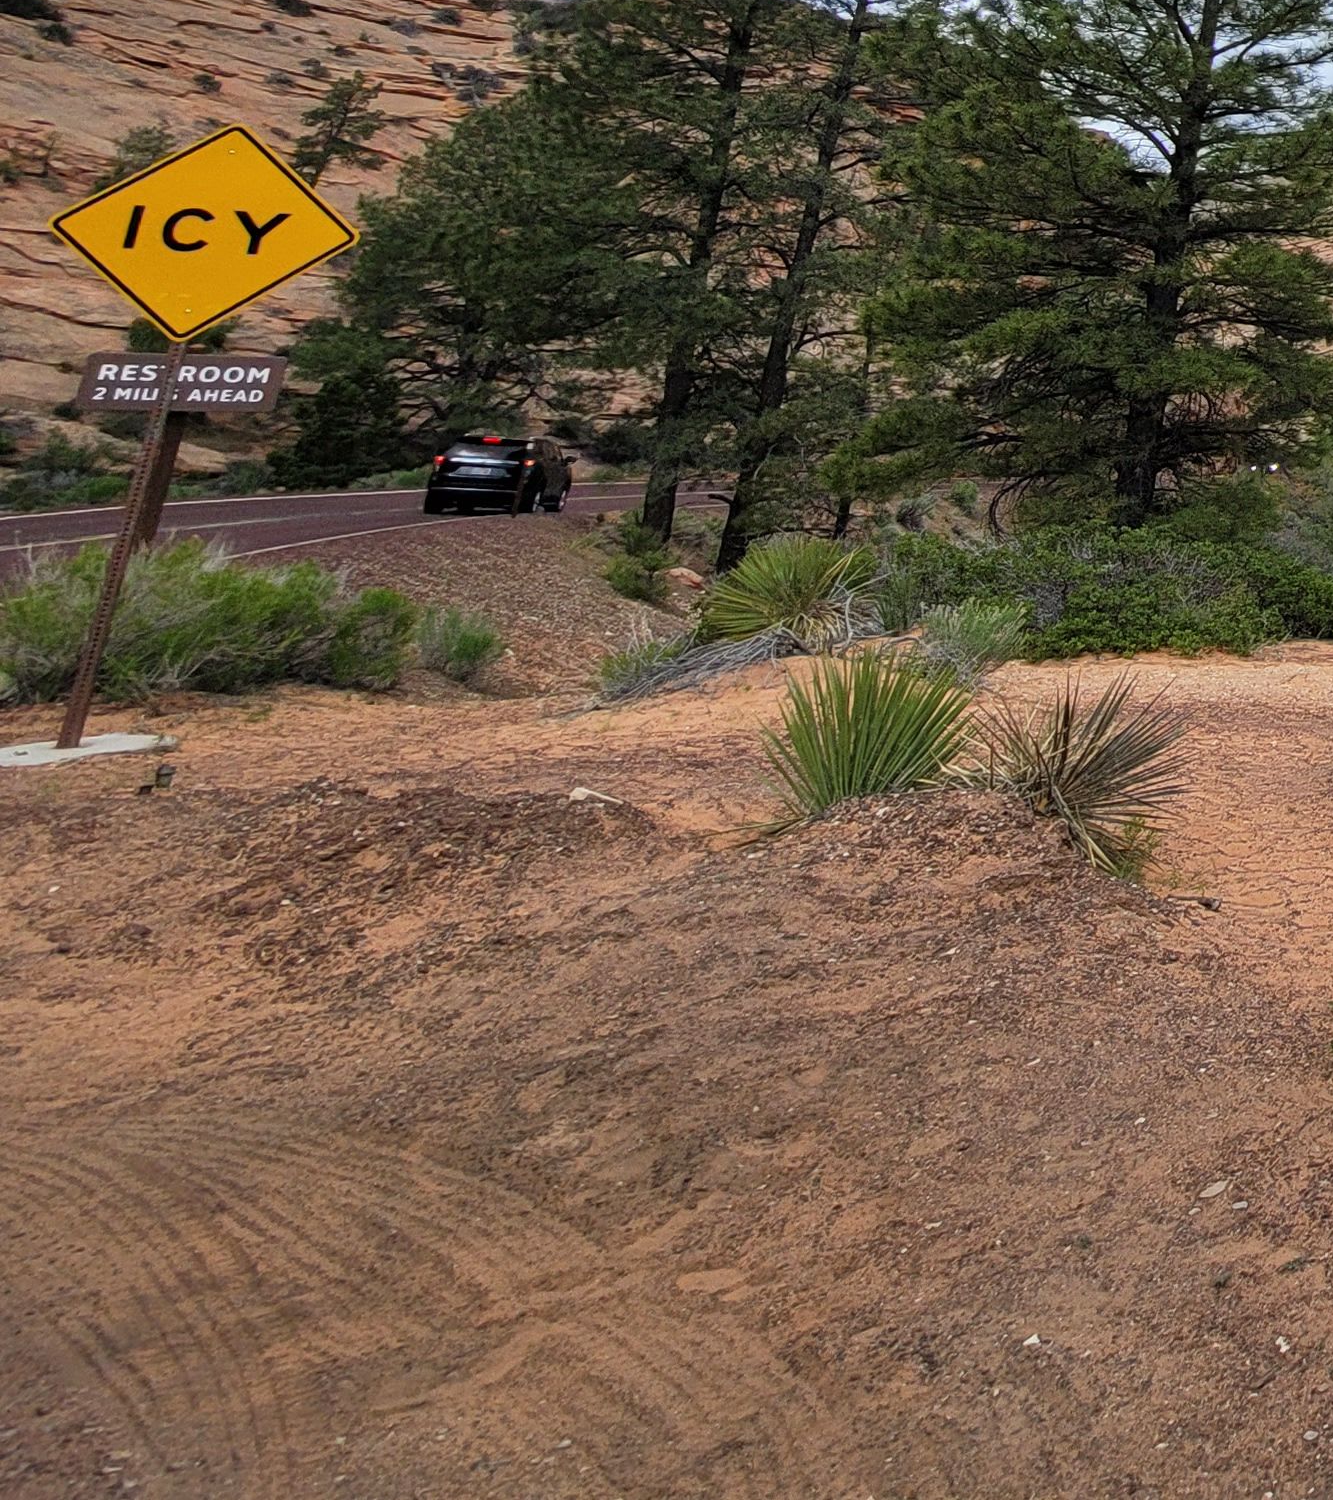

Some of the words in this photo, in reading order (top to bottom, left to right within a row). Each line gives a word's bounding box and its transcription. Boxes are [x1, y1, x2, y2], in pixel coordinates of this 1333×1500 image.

[122, 205, 291, 254] ICY
[97, 363, 271, 384] RESROOM
[92, 387, 107, 400] 2
[187, 389, 264, 403] AHEAD
